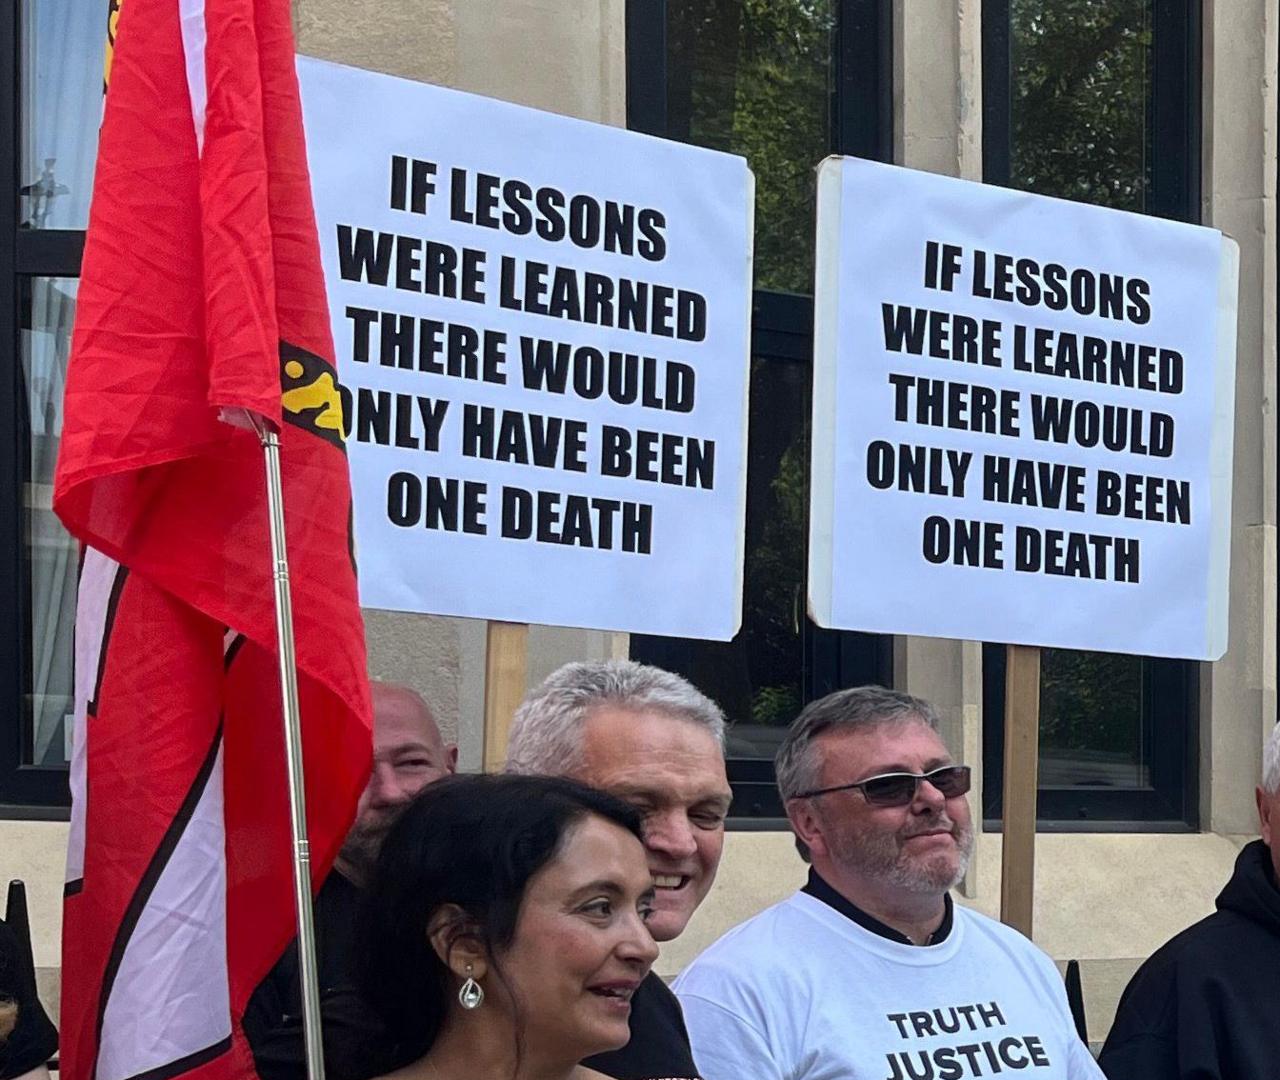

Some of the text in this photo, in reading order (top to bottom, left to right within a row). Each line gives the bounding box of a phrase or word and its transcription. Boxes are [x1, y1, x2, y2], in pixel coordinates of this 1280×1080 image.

[389, 156, 667, 261] IF LESSONS
[338, 225, 707, 342] WERE LEARNED
[887, 1001, 1006, 1039] TRUTH
